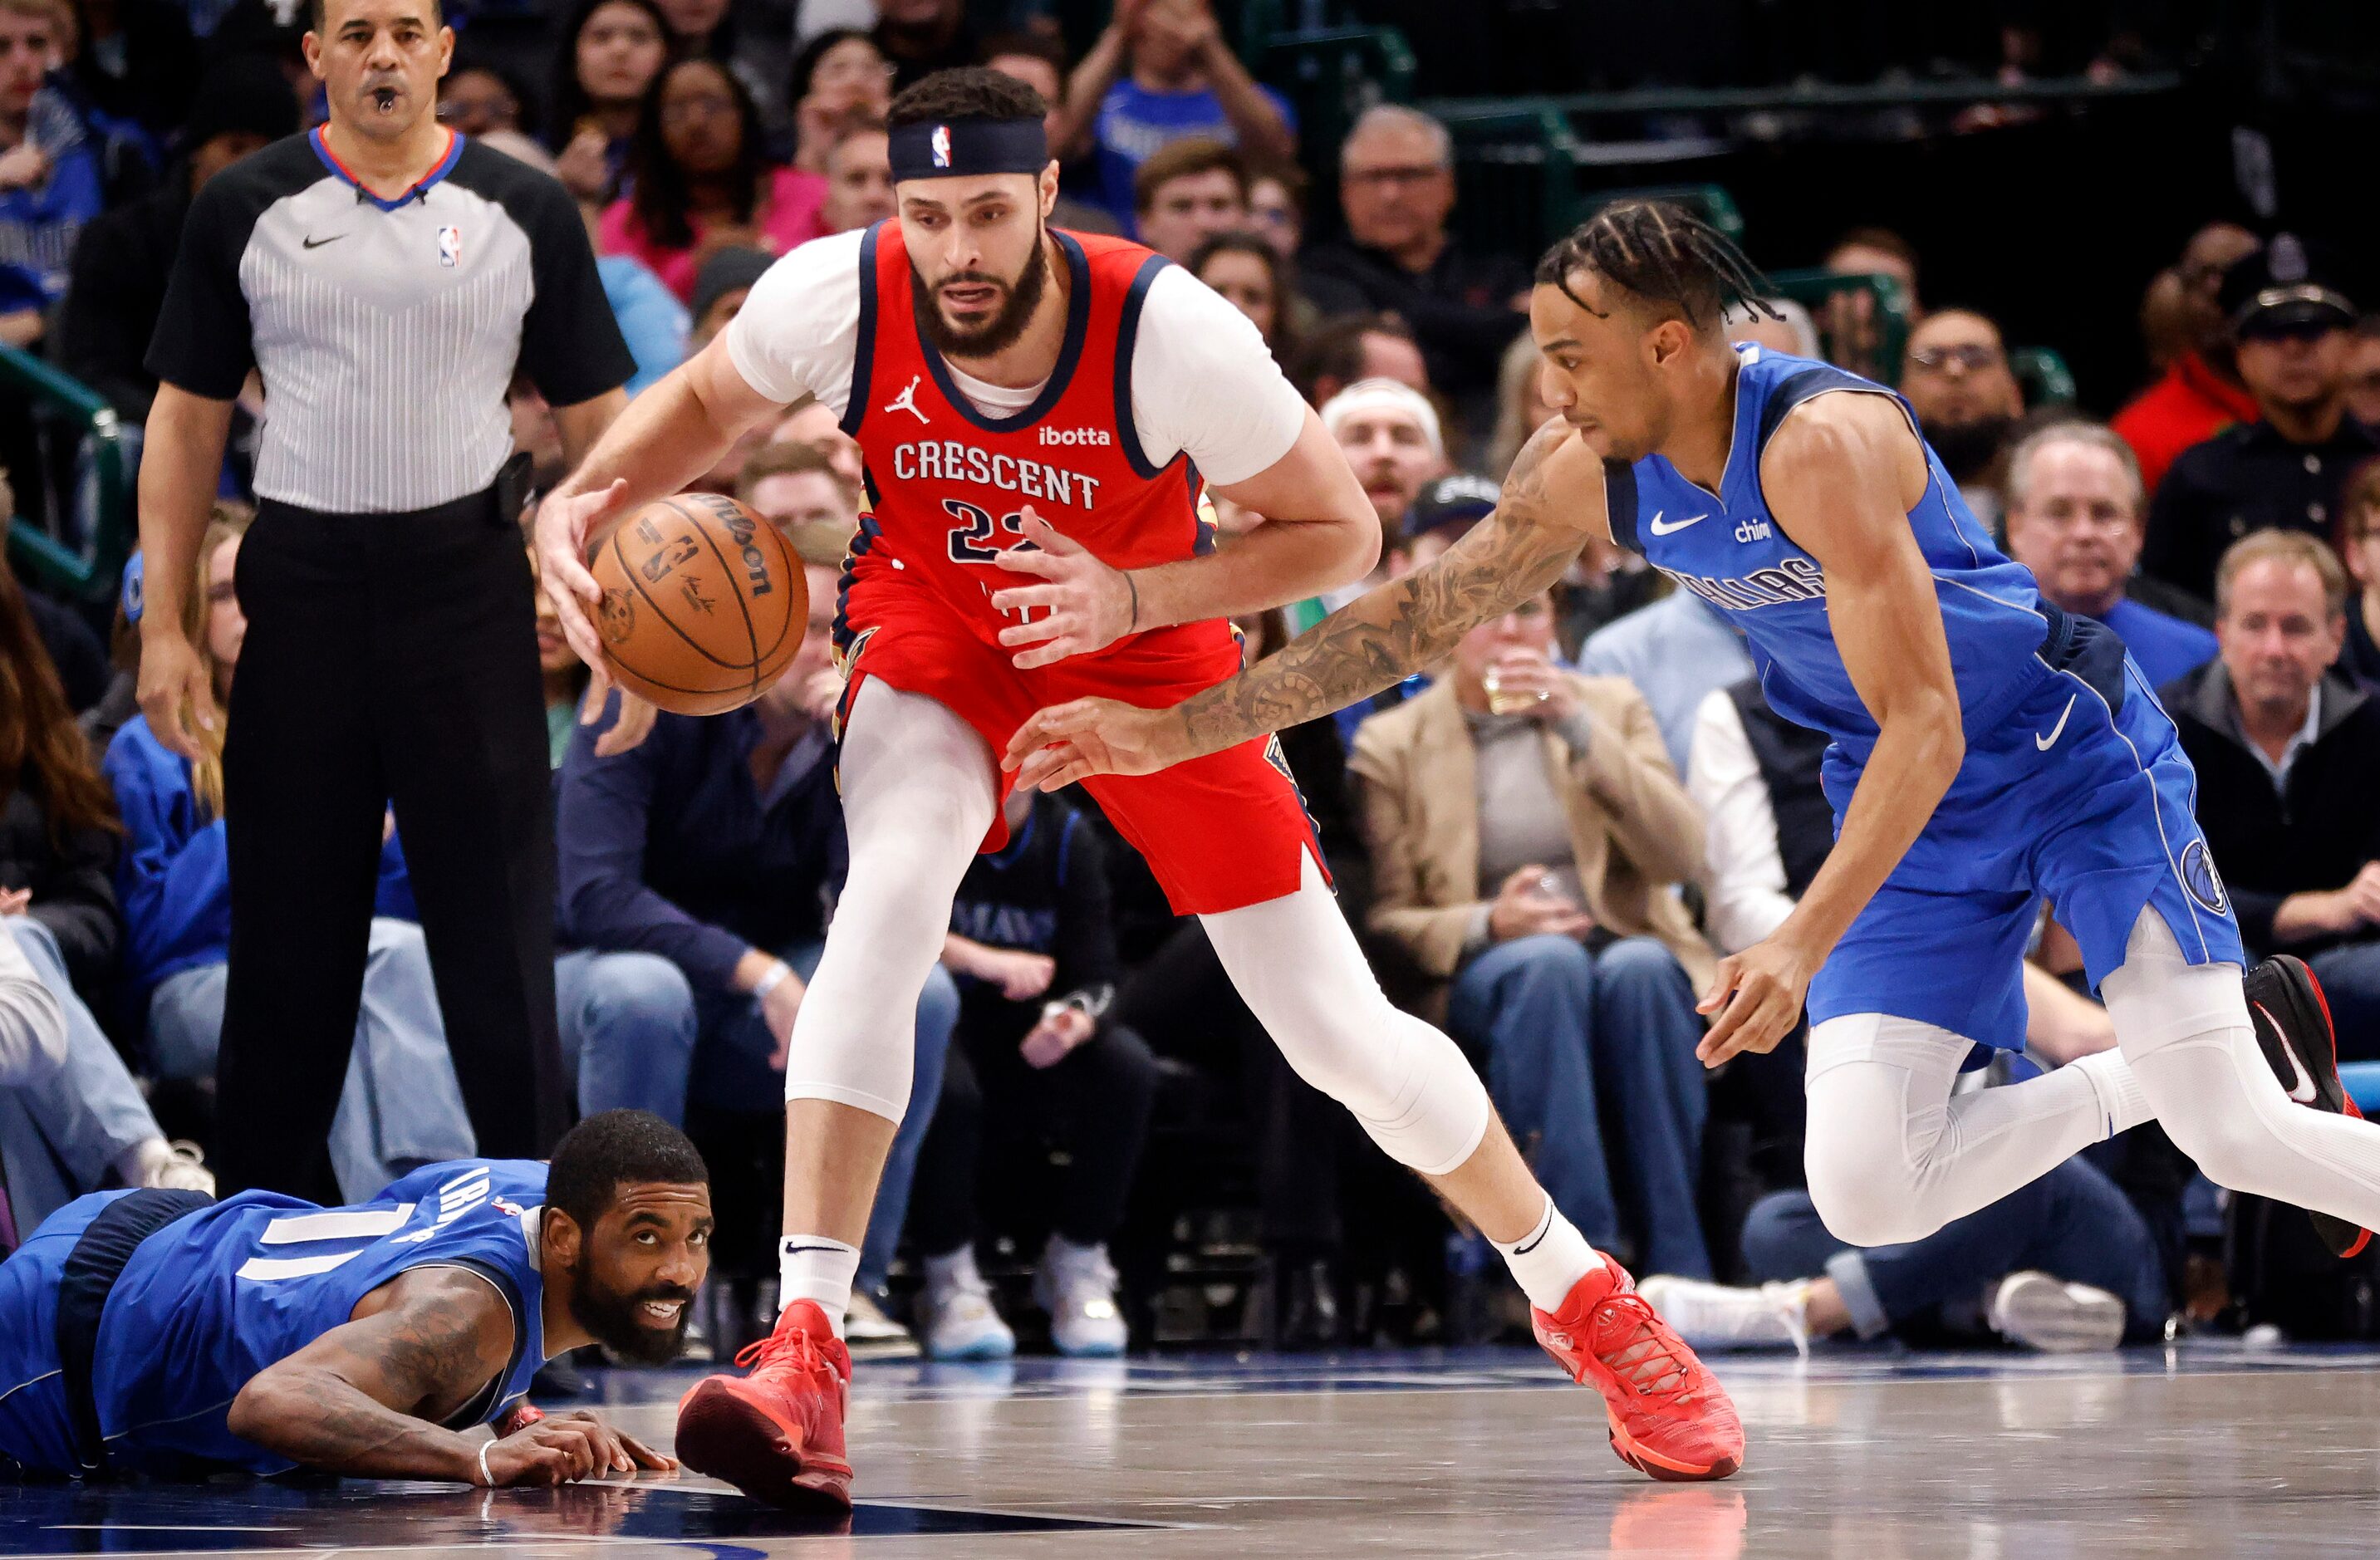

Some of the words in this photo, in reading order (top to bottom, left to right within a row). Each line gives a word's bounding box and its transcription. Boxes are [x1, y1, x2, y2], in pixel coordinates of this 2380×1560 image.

[1039, 426, 1111, 446] ibotta
[894, 439, 1101, 510] CRESCENT
[1735, 518, 1772, 543] chim
[1651, 557, 1827, 611] ALLAS
[235, 1202, 417, 1281] 11
